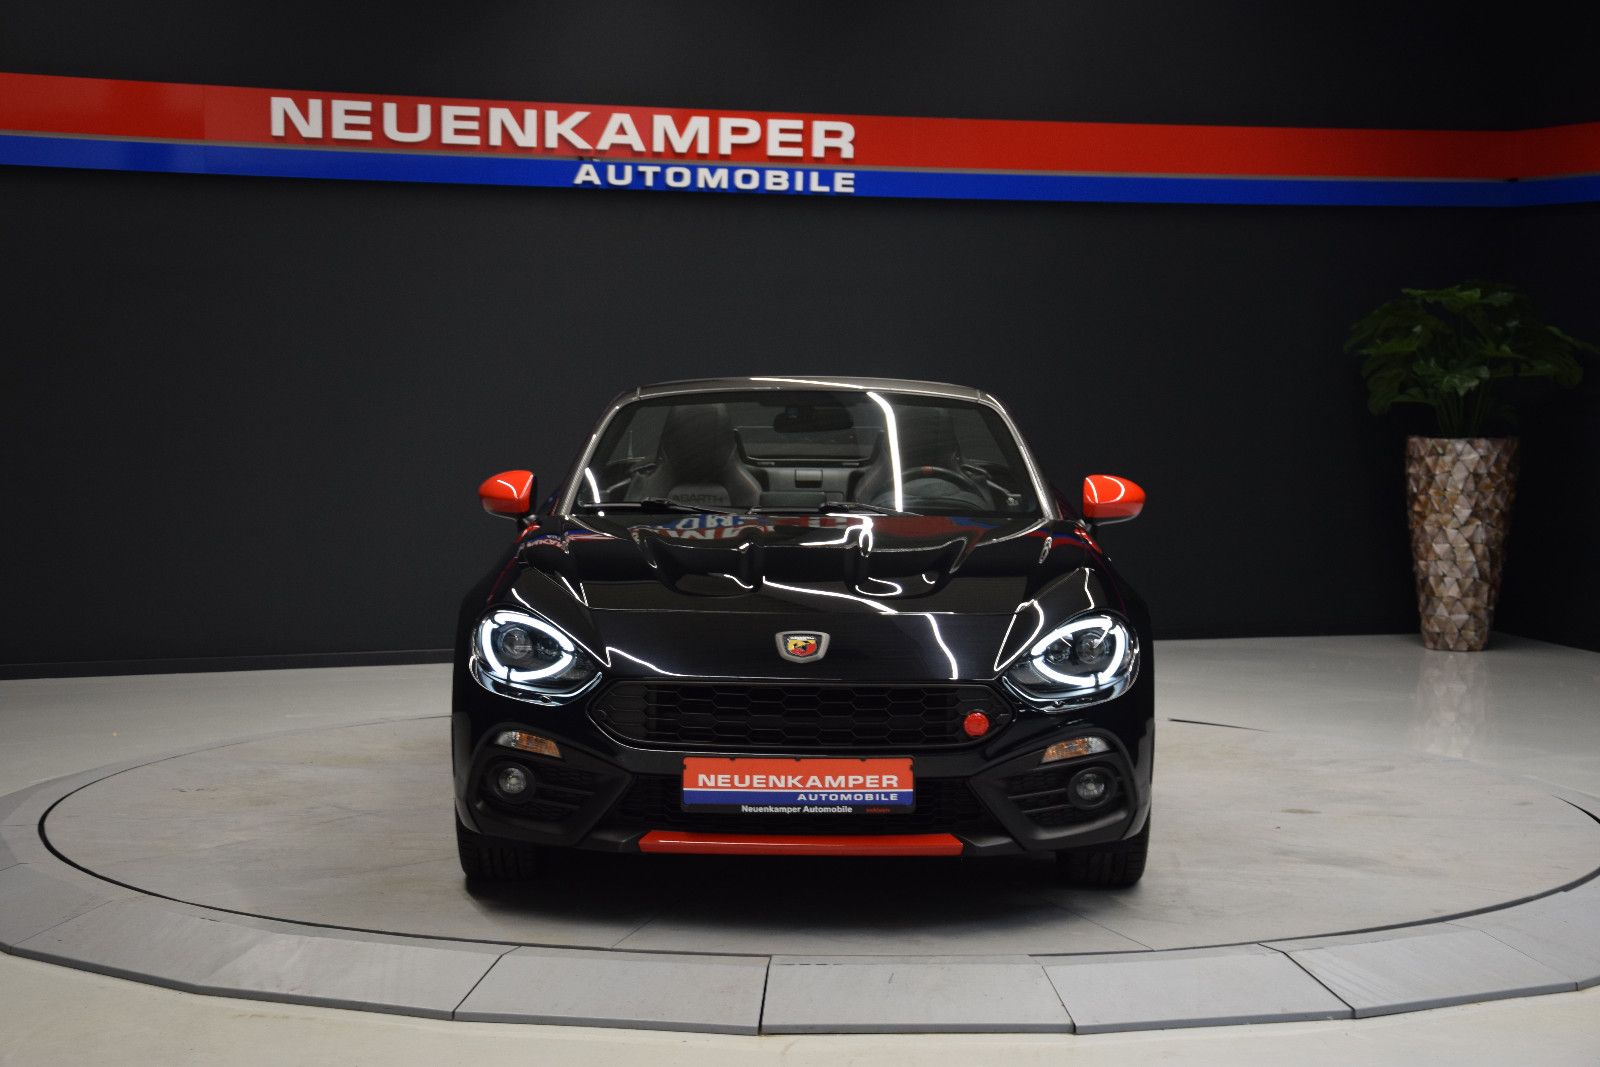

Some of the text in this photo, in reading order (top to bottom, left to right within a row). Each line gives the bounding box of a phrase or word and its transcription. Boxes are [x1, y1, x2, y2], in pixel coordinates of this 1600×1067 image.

[269, 96, 856, 160] NEUENKAMPER
[573, 162, 856, 194] AUTOMOBILE
[672, 494, 722, 503] ABARTH
[697, 773, 899, 788] NEUENKAMPER
[797, 793, 899, 801] AUTOMOBILE
[741, 805, 853, 814] Neuenkamper Automobile
